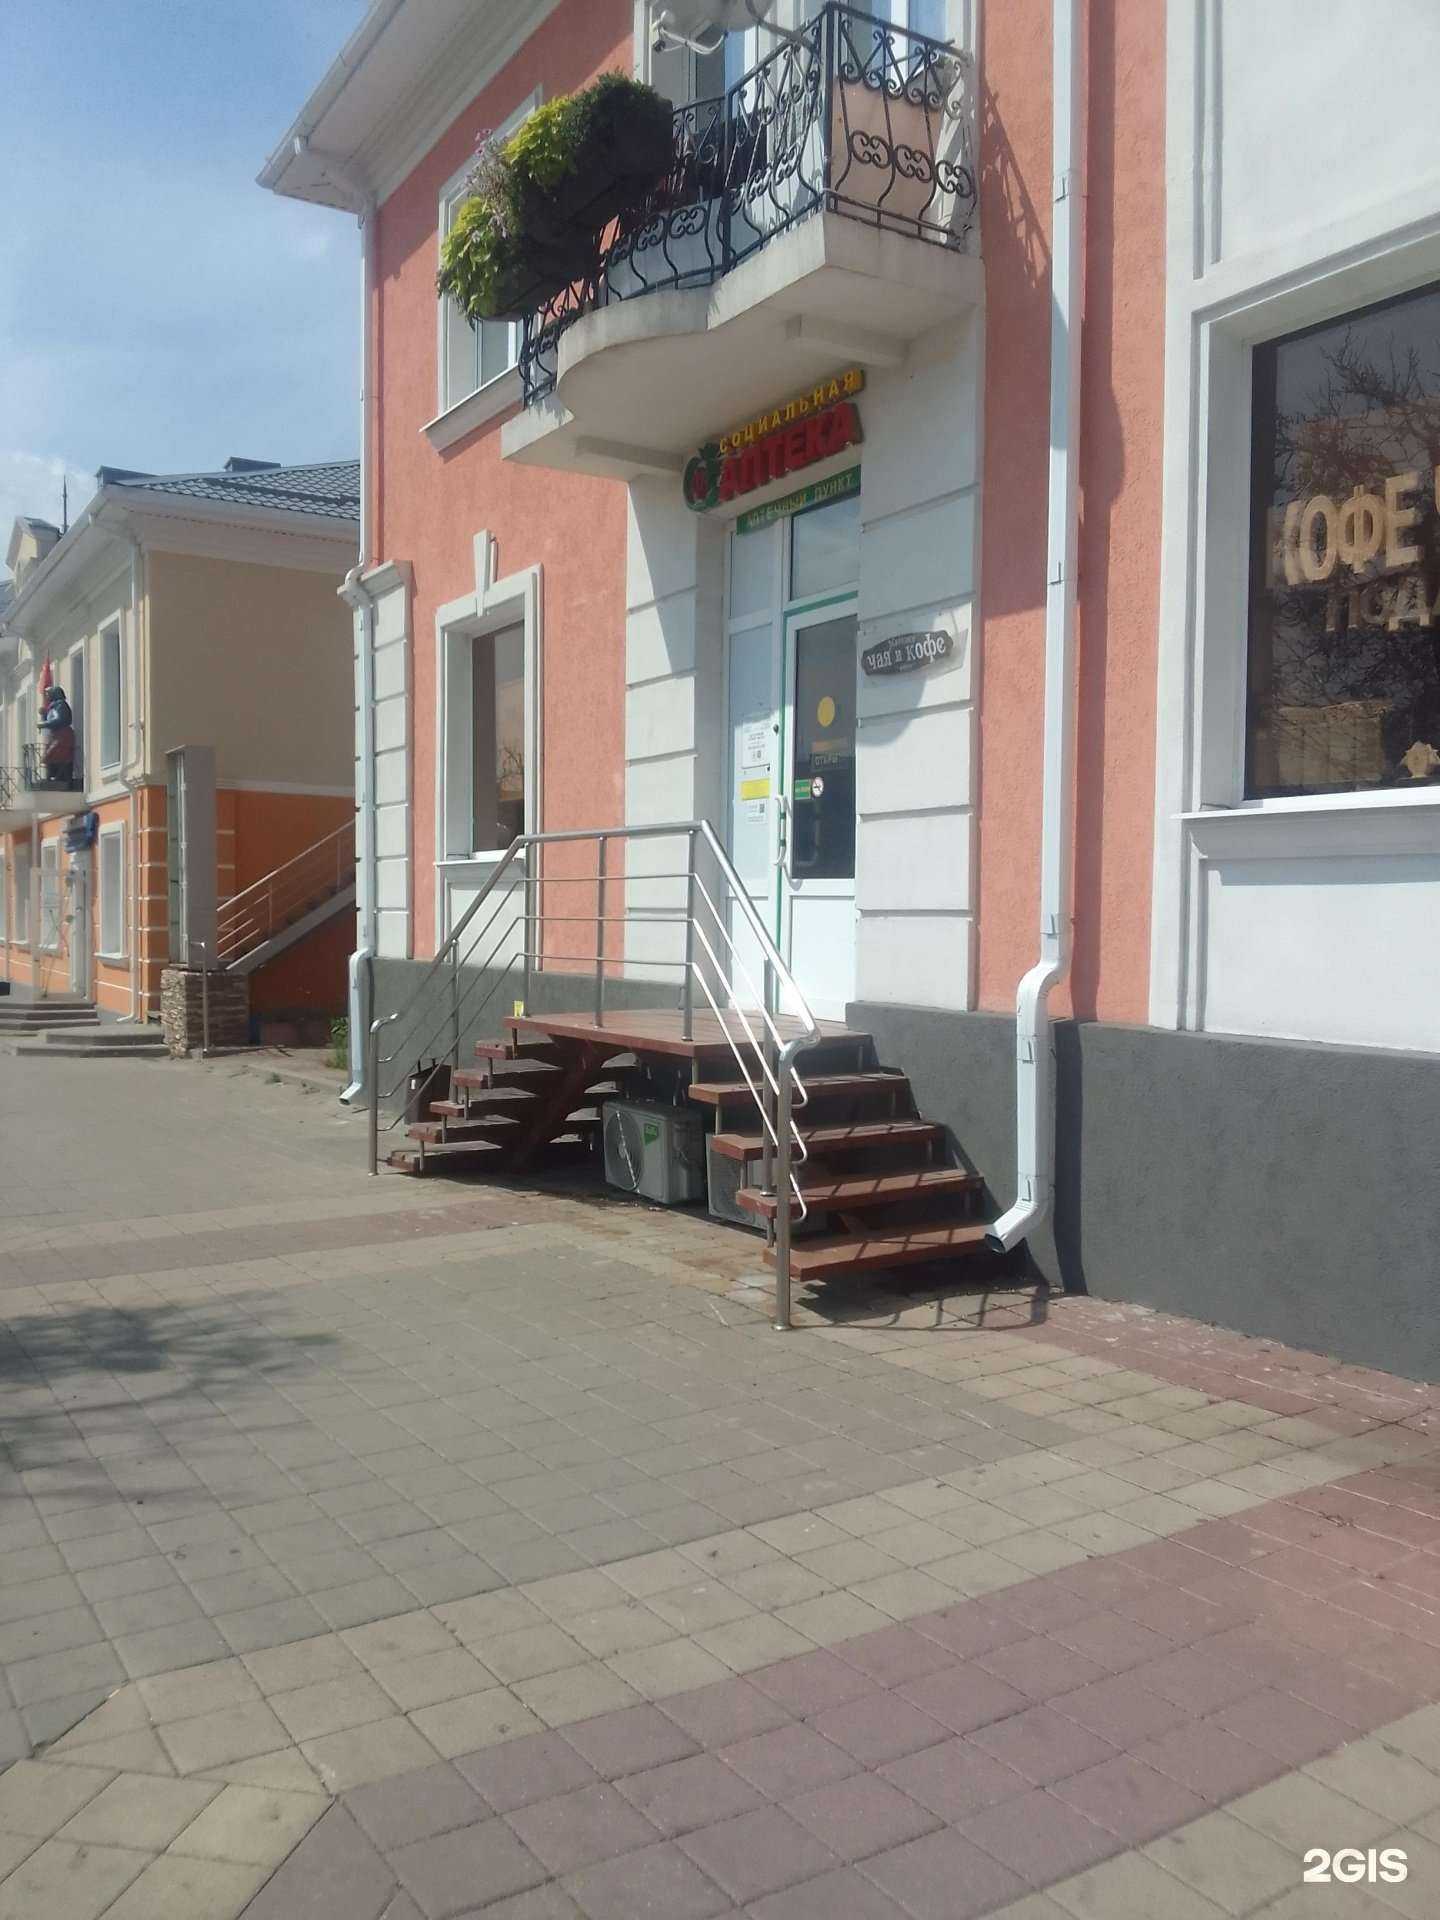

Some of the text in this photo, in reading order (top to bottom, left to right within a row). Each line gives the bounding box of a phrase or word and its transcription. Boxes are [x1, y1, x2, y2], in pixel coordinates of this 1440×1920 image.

[719, 369, 860, 454] СОЦИАЛЬНАЯ
[718, 402, 864, 505] АПТЕКА
[814, 473, 854, 502] ПУНКТ
[905, 633, 946, 664] кофе
